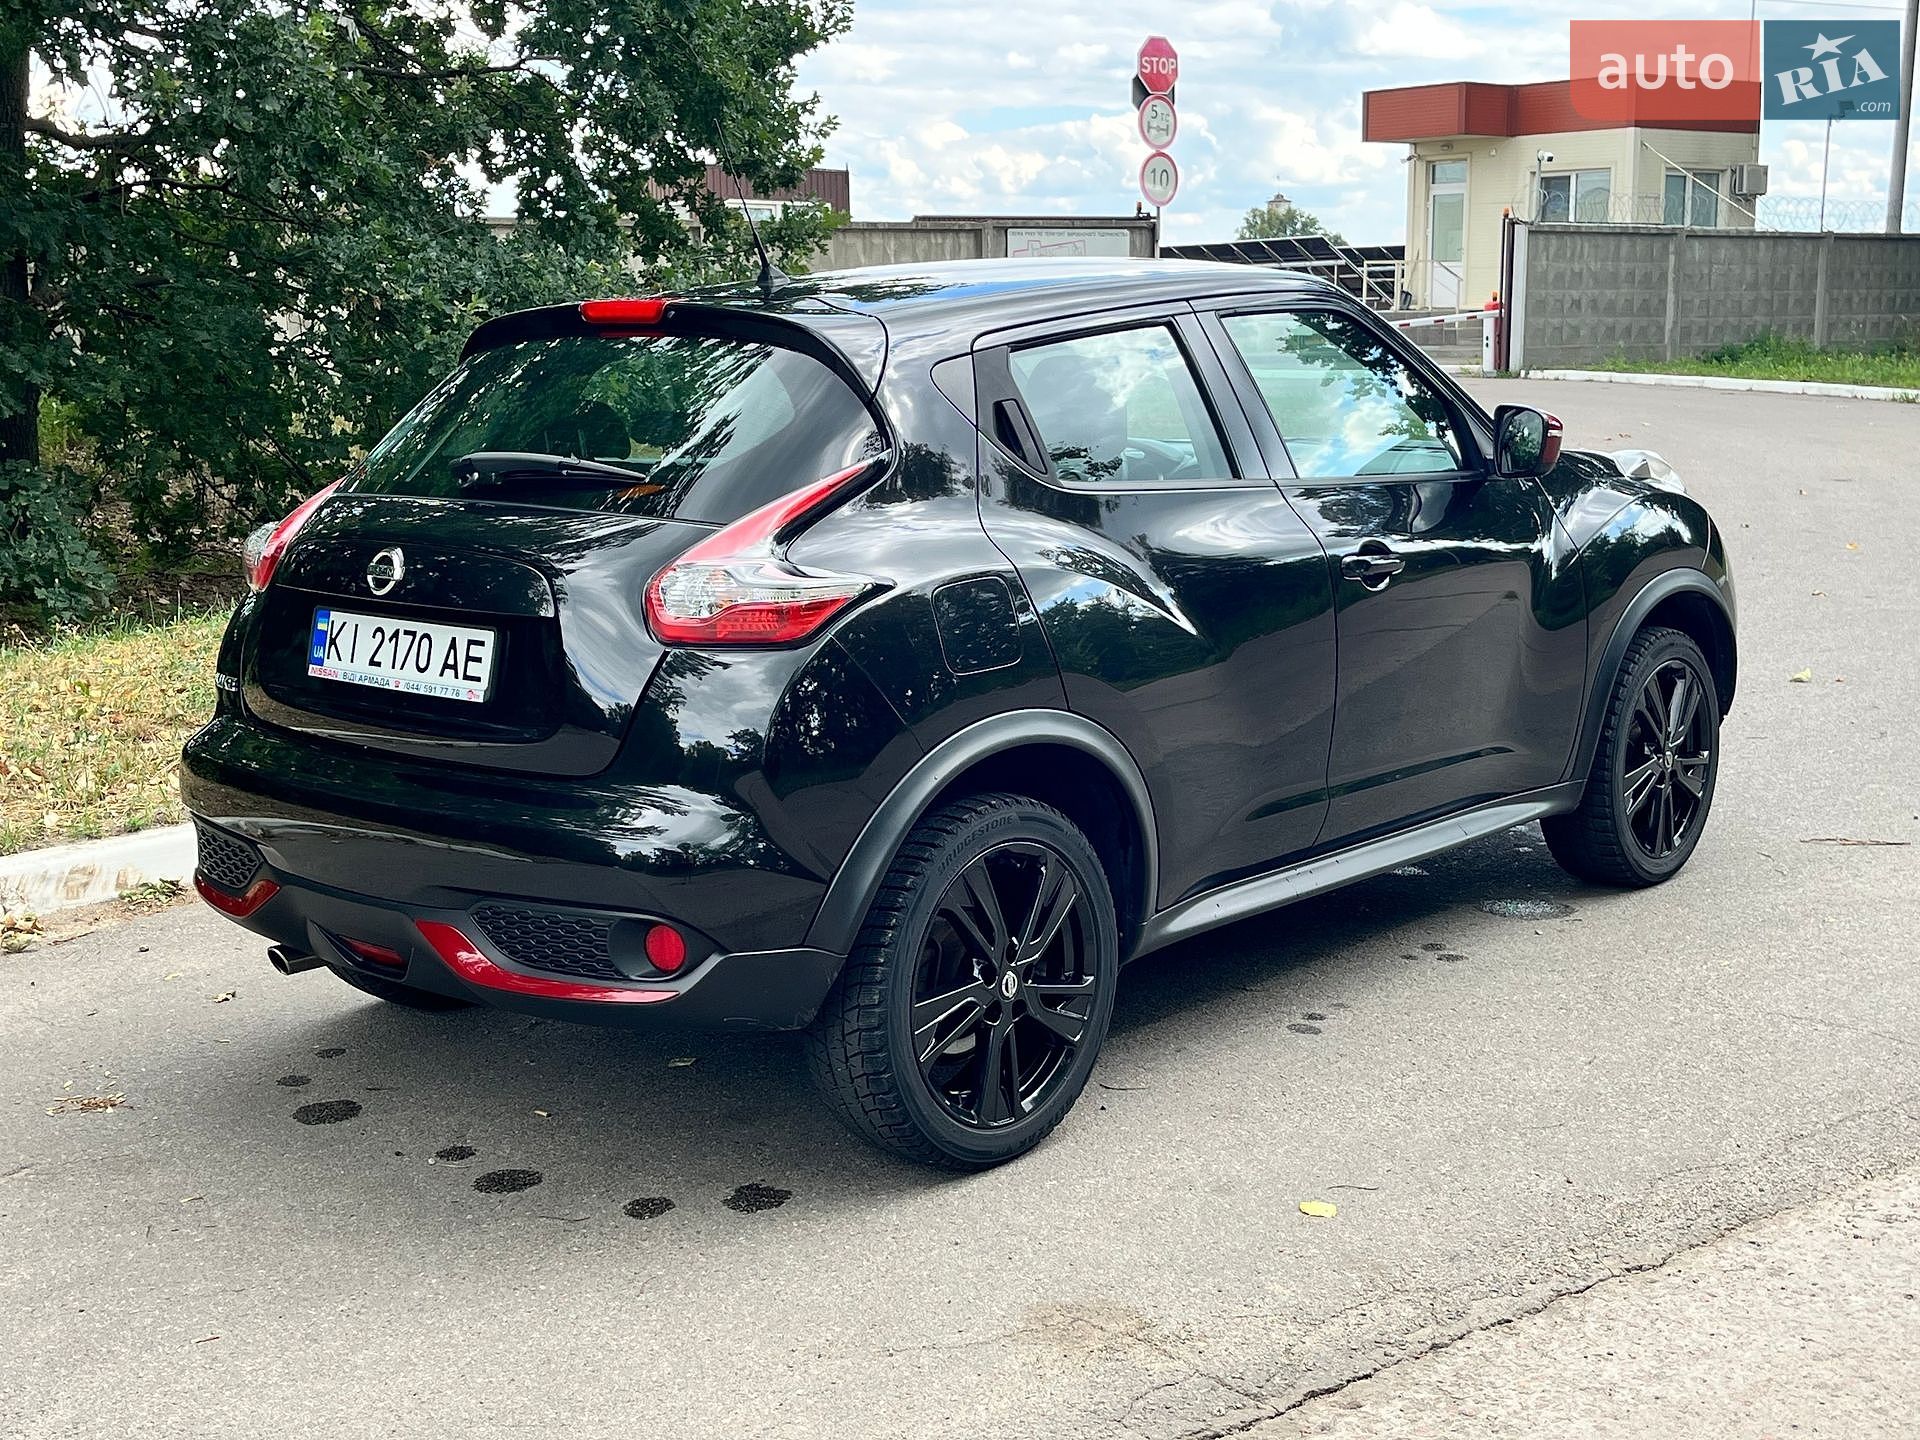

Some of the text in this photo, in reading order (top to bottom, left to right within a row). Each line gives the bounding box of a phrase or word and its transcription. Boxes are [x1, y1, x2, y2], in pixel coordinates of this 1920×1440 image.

[1141, 56, 1177, 75] STOP
[1151, 104, 1158, 120] 5
[1150, 167, 1169, 188] 10
[313, 645, 324, 658] UA
[327, 620, 486, 683] KI 2170 AE
[310, 666, 339, 679] NISSAN
[423, 684, 437, 694] 591
[440, 687, 449, 696] 77
